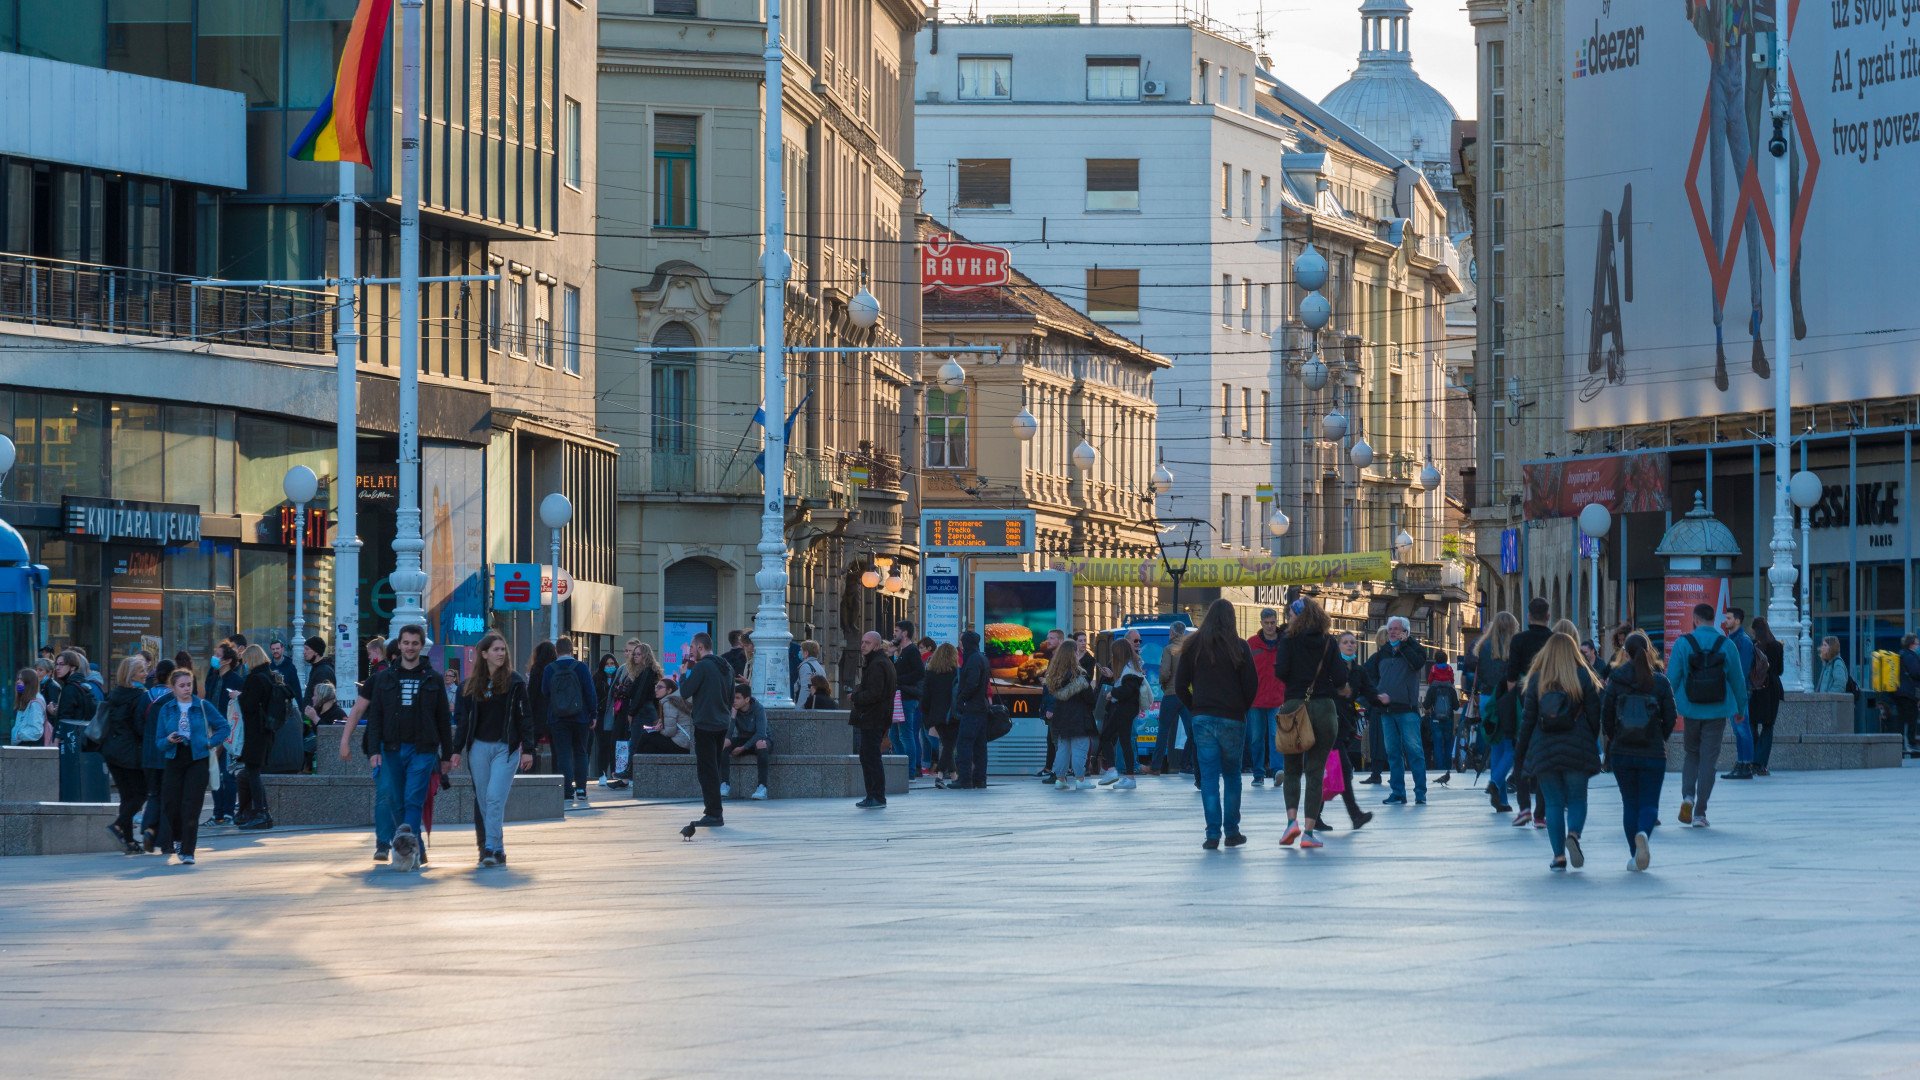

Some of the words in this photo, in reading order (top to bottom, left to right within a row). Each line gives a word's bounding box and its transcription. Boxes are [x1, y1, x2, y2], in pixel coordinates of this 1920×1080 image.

[1855, 0, 1896, 31] svoju
[1588, 18, 1644, 75] deezer
[1832, 48, 1852, 93] A1
[1858, 41, 1896, 99] prati
[1833, 118, 1868, 164] tvog
[1588, 182, 1633, 374] A1
[356, 475, 397, 488] PELATI
[88, 500, 151, 542] KNJIŽARA
[157, 511, 201, 546] LJEVAK
[281, 505, 328, 548] PEATI
[1869, 534, 1893, 547] PARIS
[541, 576, 567, 587] Fres
[1682, 583, 1704, 592] ATRIUM
